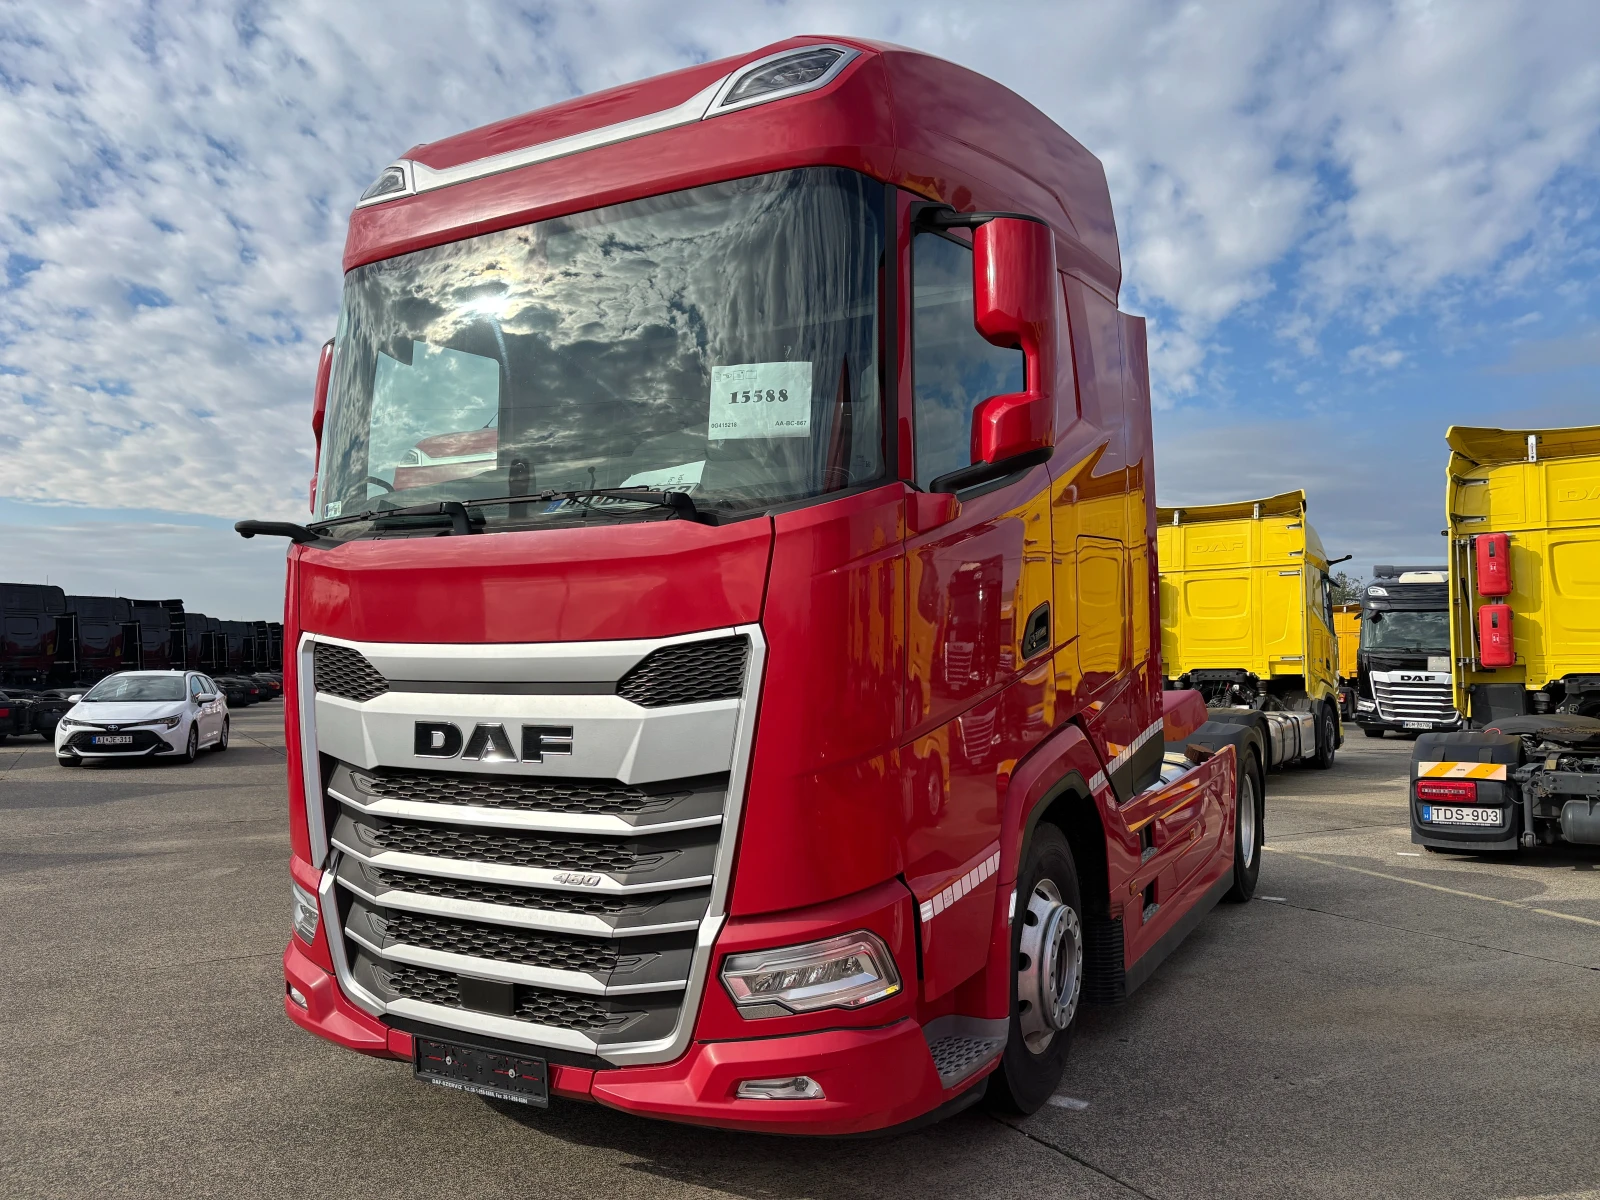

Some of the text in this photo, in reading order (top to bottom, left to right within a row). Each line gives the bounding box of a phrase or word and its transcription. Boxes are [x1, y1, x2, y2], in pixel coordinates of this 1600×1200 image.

[728, 388, 789, 405] 15588
[1191, 540, 1245, 554] DAF
[413, 720, 574, 764] DAF
[1433, 808, 1499, 823] TDS-903
[553, 872, 601, 887] 480
